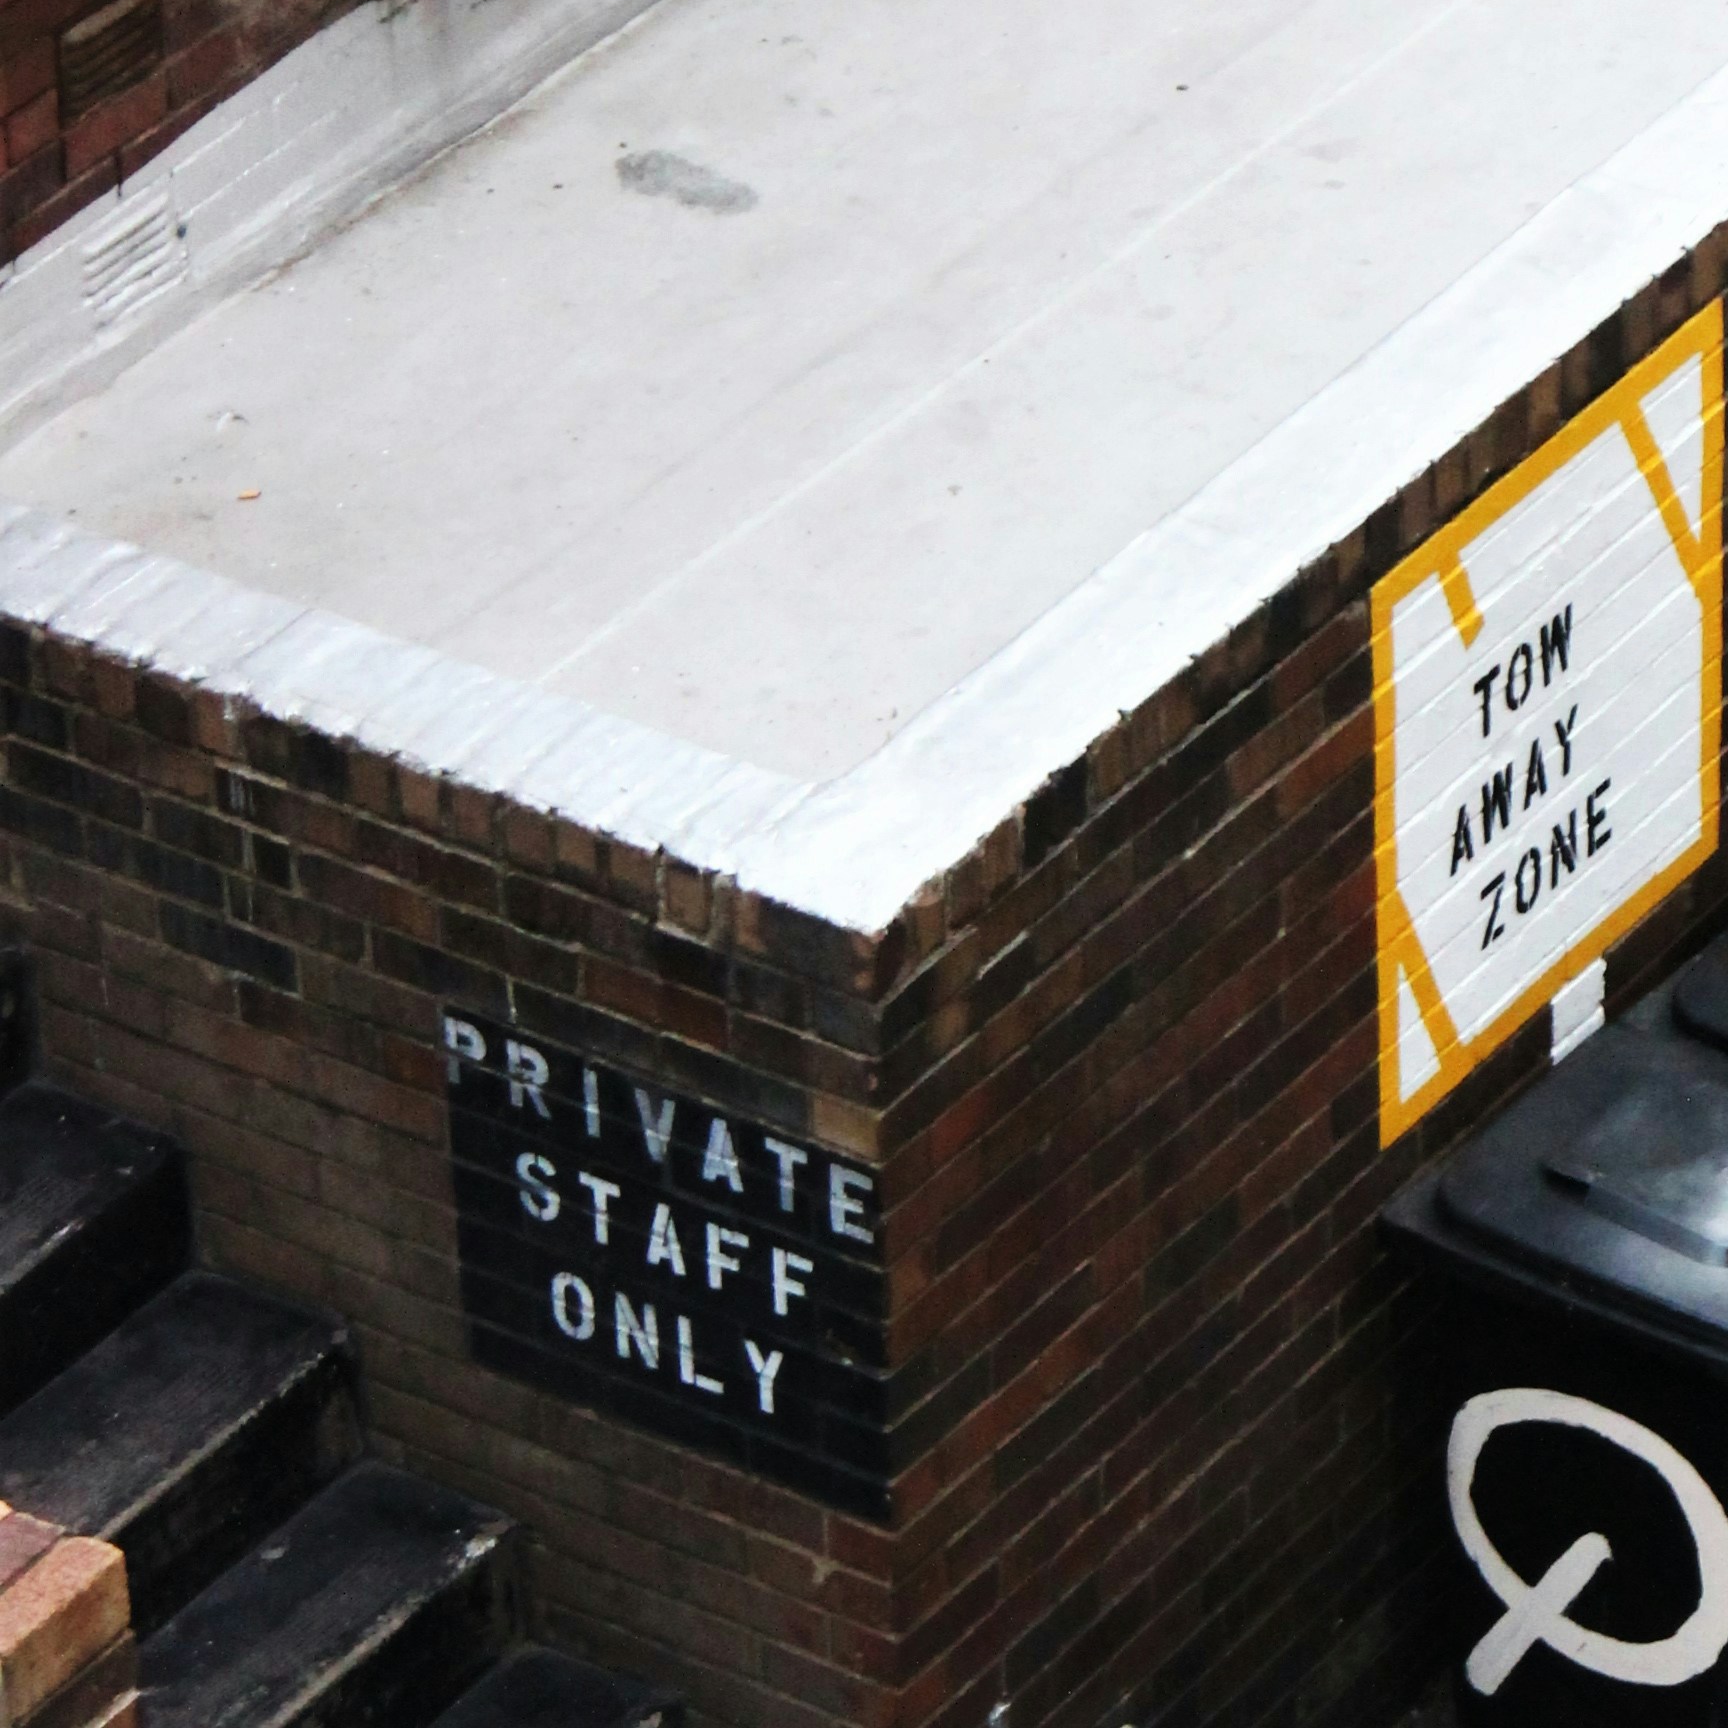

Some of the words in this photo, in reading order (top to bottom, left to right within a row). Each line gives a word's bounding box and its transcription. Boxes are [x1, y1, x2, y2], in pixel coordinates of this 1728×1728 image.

[1474, 603, 1572, 738] TOW
[1450, 704, 1578, 877] AWAY
[1480, 778, 1612, 950] ZONE
[443, 1017, 874, 1244] PRIVATE
[515, 1153, 813, 1316] STAFF
[551, 1272, 784, 1414] ONLY
